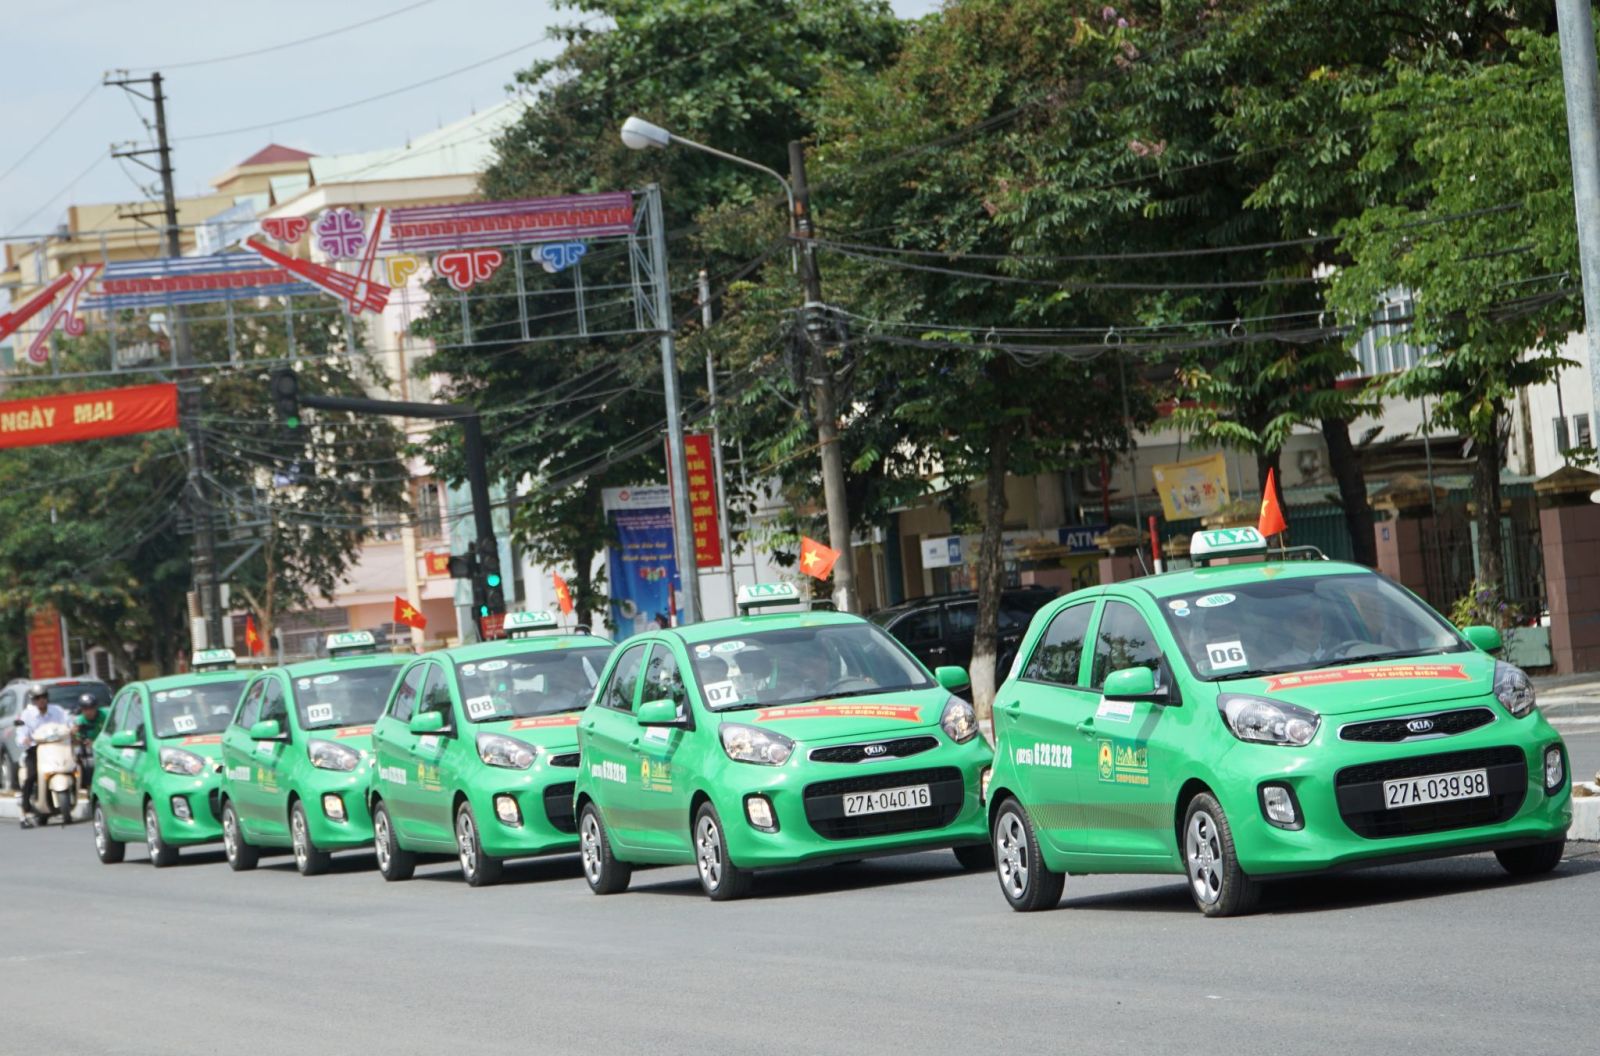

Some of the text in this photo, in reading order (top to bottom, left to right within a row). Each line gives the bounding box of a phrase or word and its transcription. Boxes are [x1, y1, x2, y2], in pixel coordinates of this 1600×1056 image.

[1, 401, 114, 432] NGÀY MAI
[1211, 647, 1243, 664] 06
[708, 686, 733, 701] 07
[310, 707, 330, 718] 09
[470, 700, 492, 714] 08
[176, 719, 194, 728] 10
[1411, 720, 1432, 731] KIA
[869, 744, 885, 754] KIA
[1388, 773, 1485, 805] 27A-039.98
[847, 788, 929, 814] 27A-040.16
